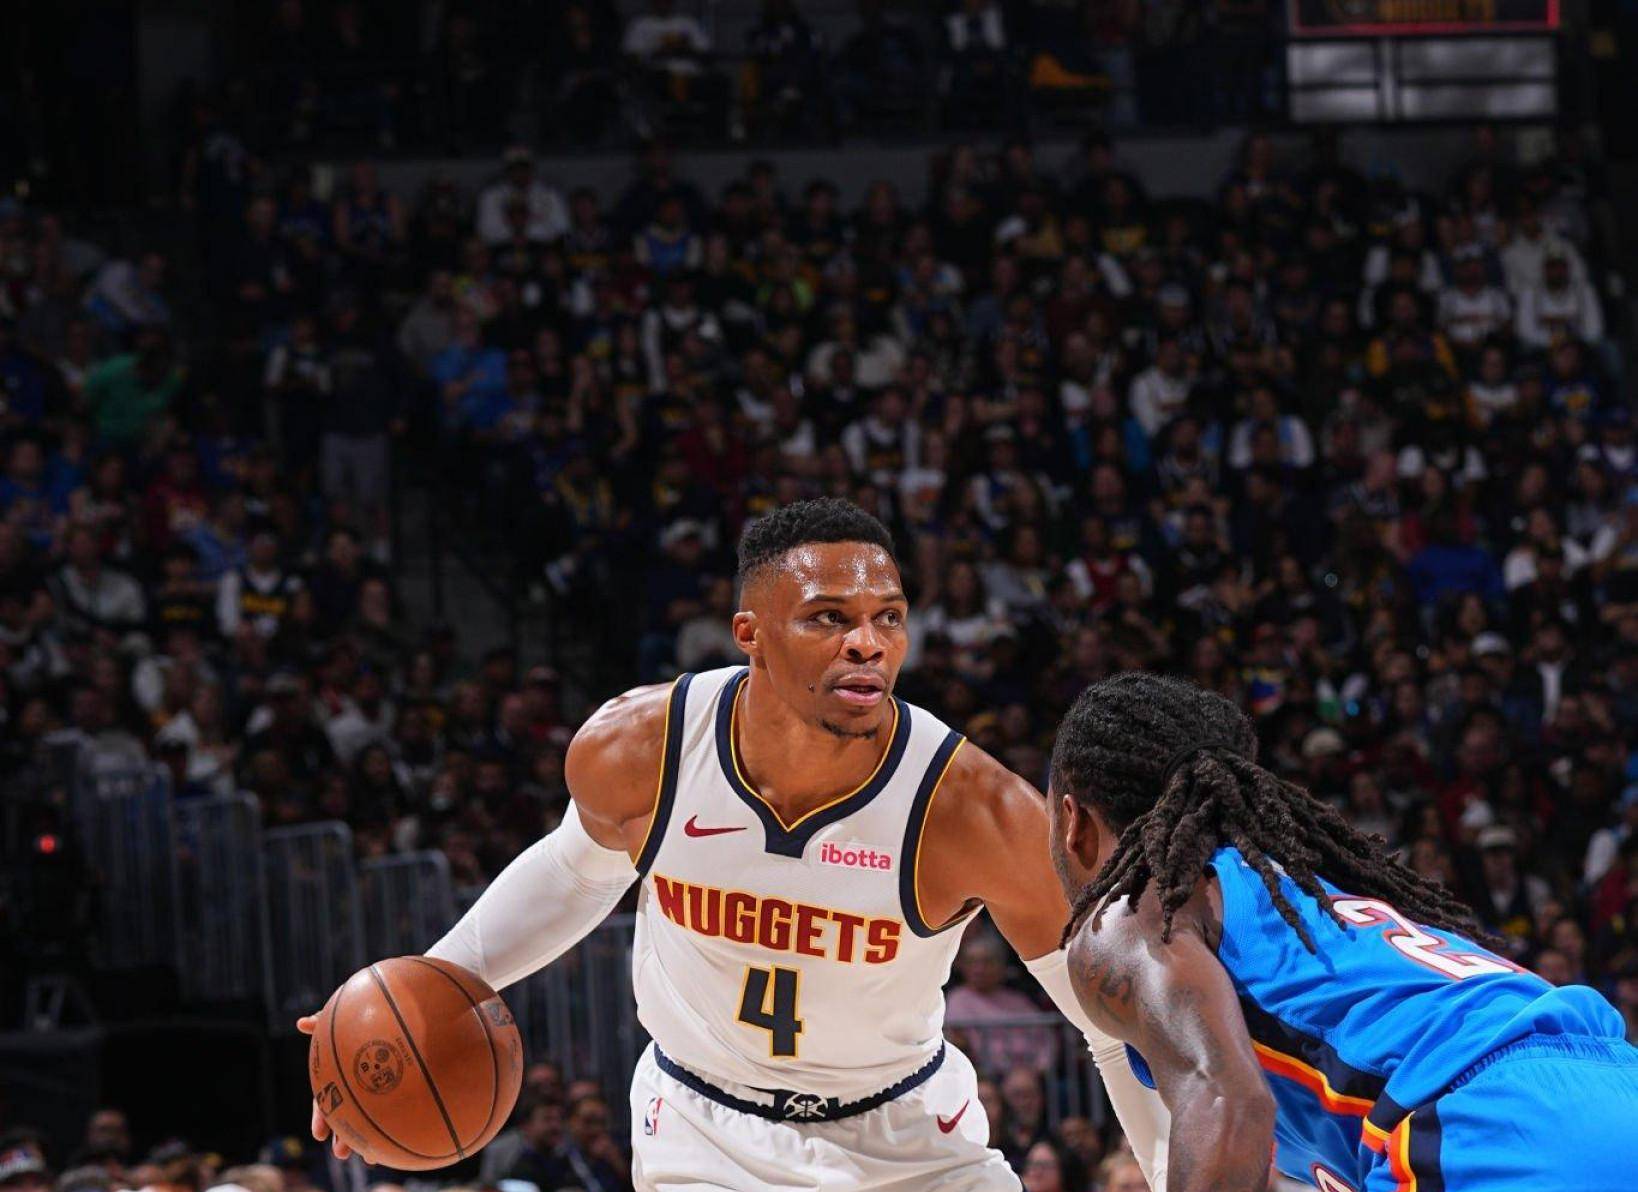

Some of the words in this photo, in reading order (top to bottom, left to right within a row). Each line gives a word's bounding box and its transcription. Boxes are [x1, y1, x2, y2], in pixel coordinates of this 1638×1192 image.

[821, 843, 891, 870] ibotta
[653, 874, 901, 965] NUGGETS
[734, 963, 805, 1058] 4
